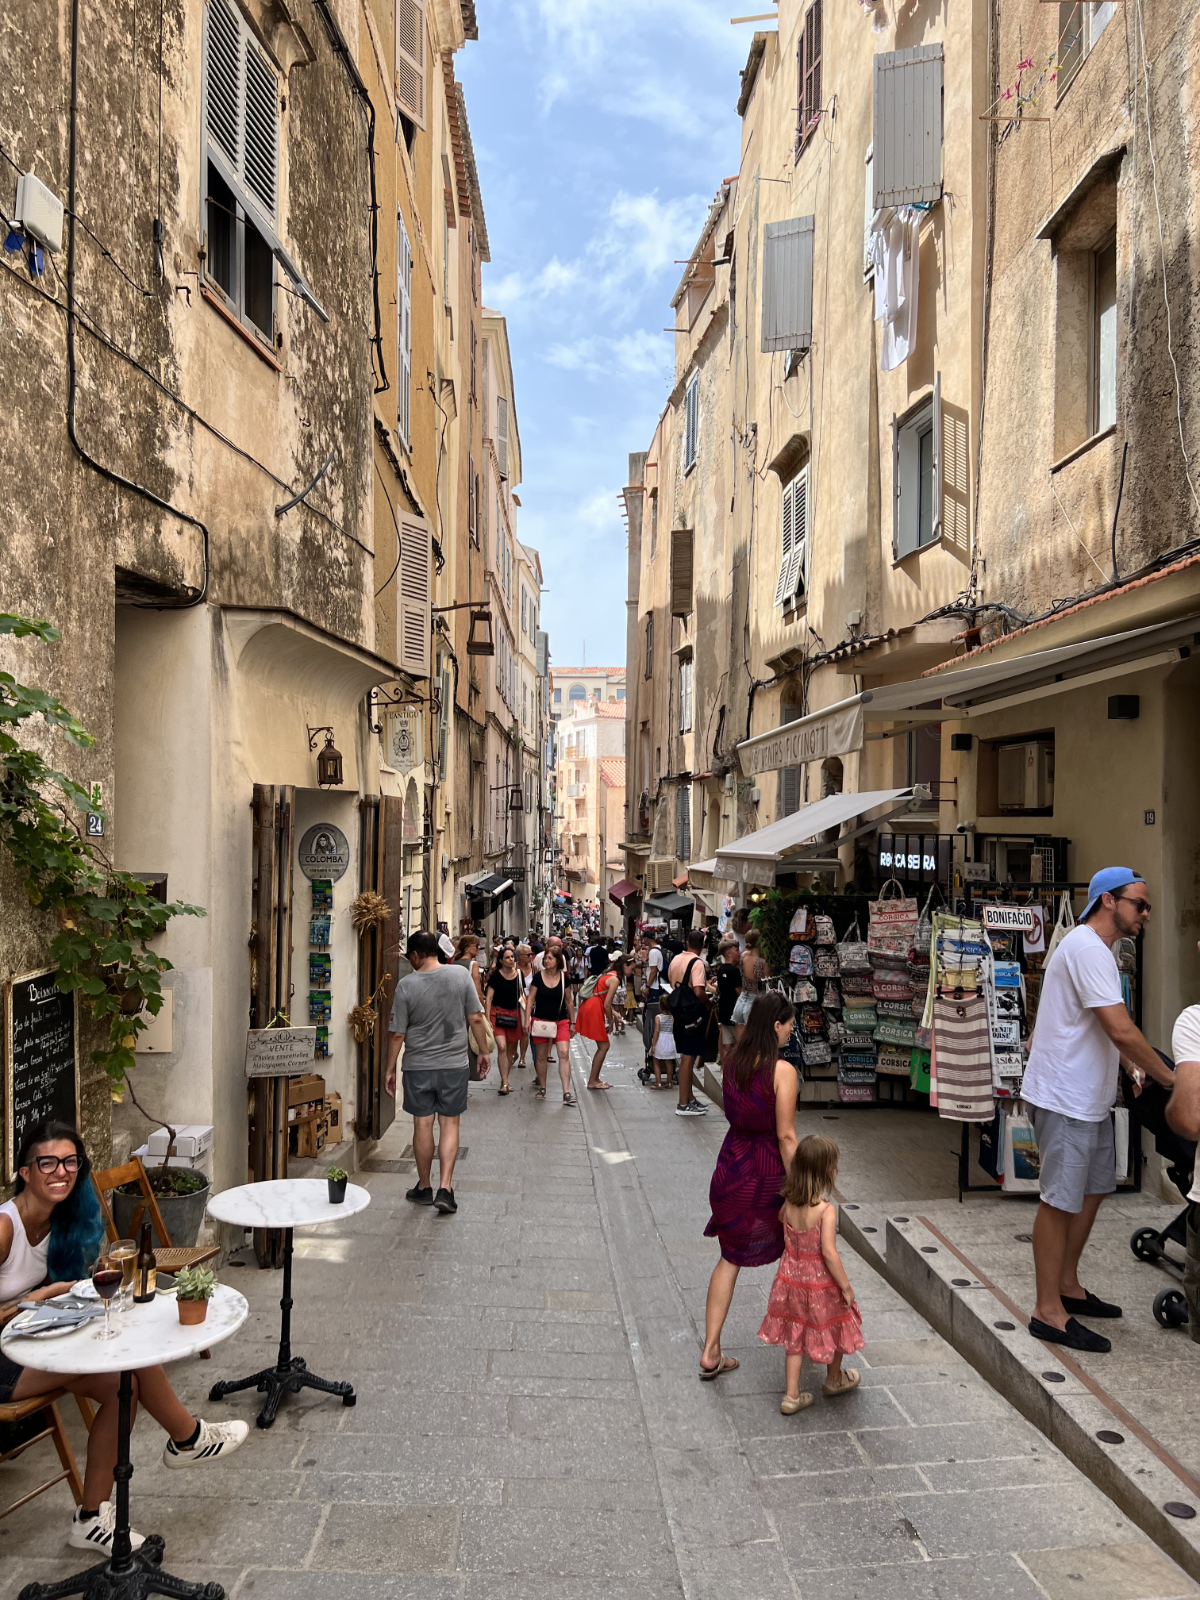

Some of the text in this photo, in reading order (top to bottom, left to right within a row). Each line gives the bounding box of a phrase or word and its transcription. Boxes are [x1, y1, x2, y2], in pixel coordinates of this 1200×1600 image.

[1146, 812, 1154, 824] 19
[89, 816, 102, 833] 24
[305, 855, 343, 863] COLOMBA
[879, 912, 910, 922] CORSICA
[24, 1015, 30, 1027] de
[849, 1012, 876, 1021] CORSICA
[880, 1025, 914, 1038] CORSICA
[846, 1036, 873, 1044] CORSICA
[269, 1043, 294, 1052] VENTE
[276, 1052, 309, 1060] essentielles
[847, 1070, 873, 1078] CORSICA
